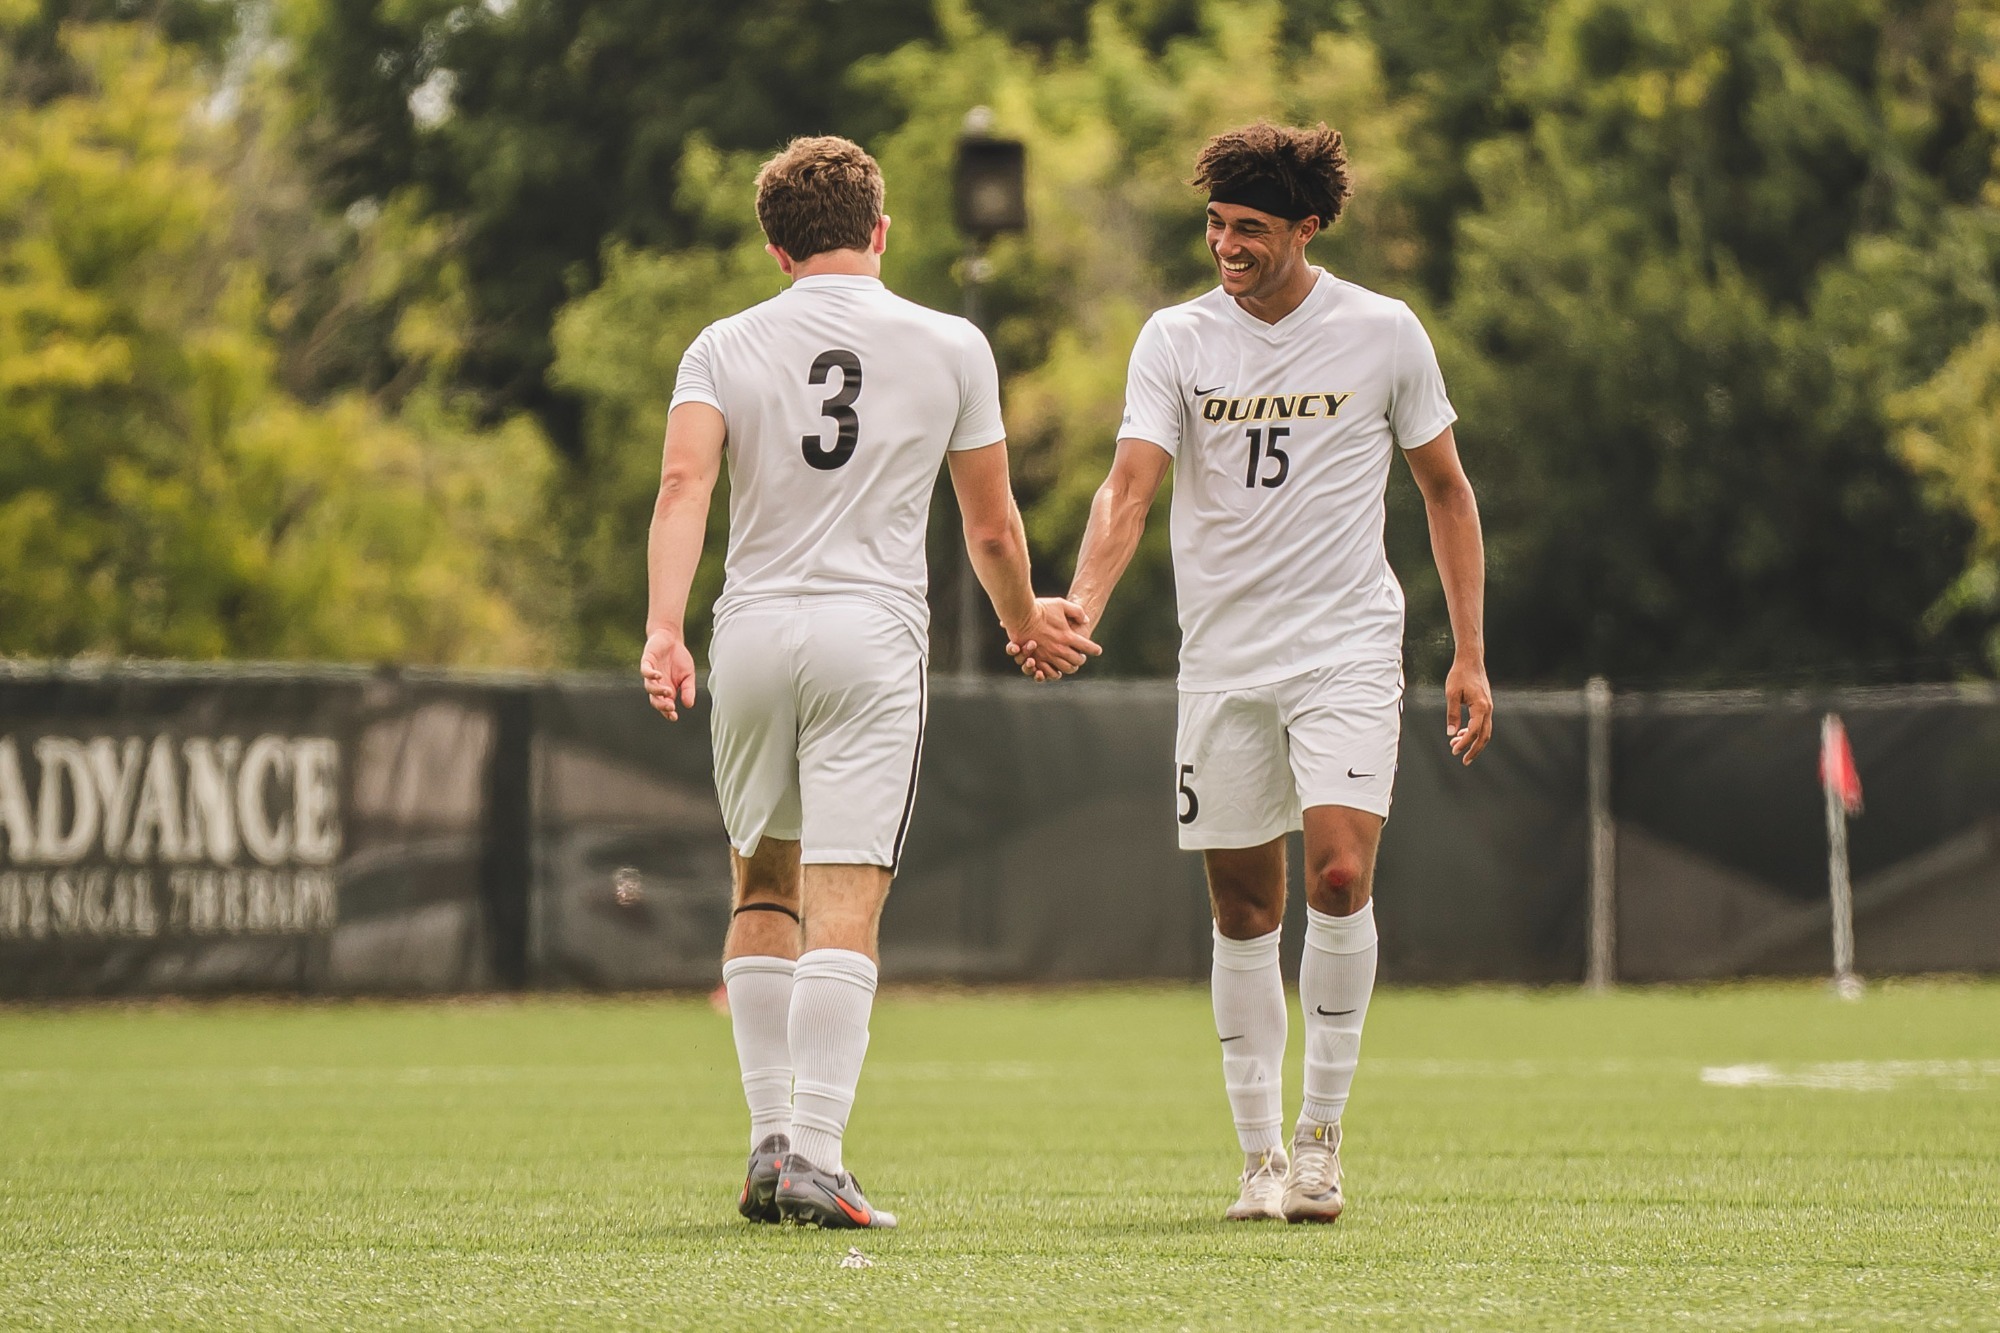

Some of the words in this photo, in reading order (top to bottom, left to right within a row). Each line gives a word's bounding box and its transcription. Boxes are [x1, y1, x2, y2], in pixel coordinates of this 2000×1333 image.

[801, 349, 863, 471] 3
[1202, 392, 1355, 424] QUINCY
[1245, 427, 1290, 489] 15
